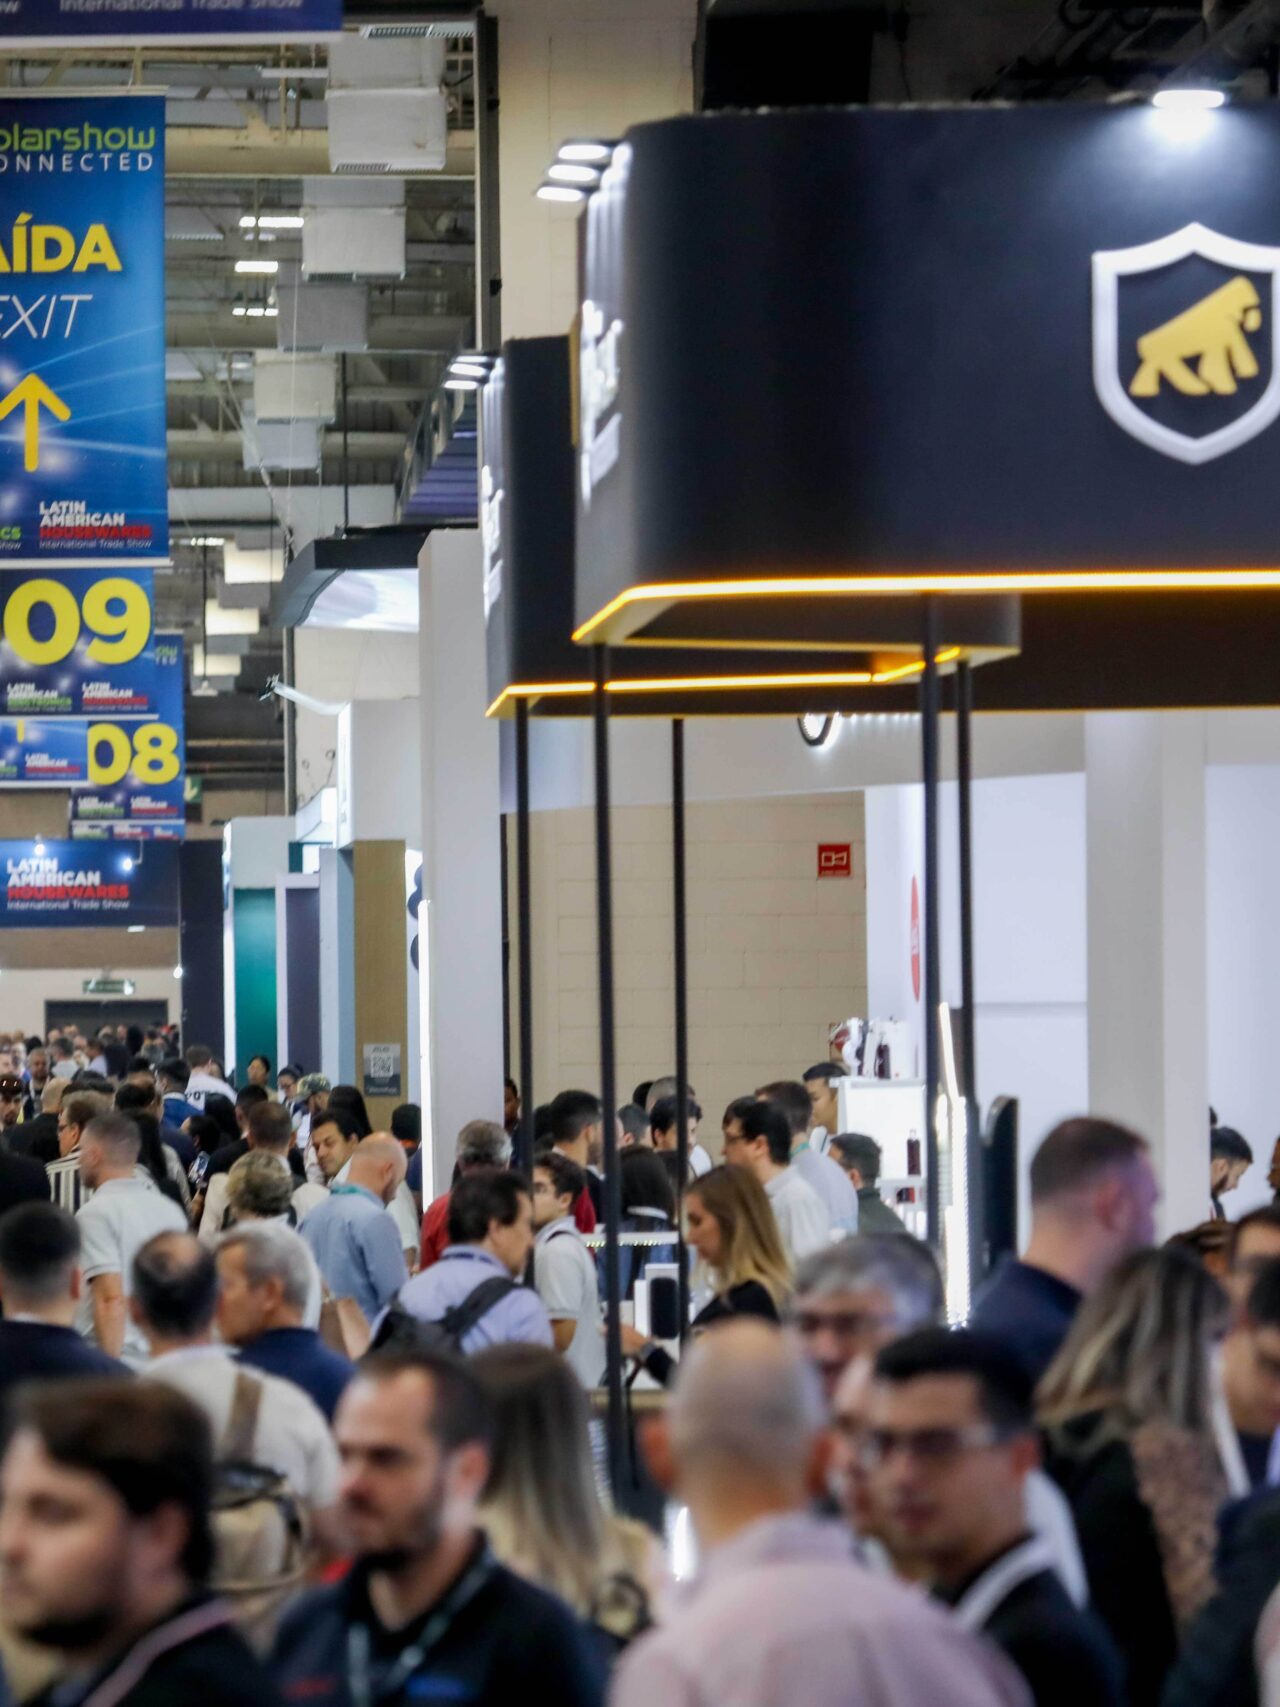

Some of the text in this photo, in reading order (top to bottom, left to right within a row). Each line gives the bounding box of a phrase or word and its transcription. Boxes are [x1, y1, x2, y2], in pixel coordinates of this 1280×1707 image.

[39, 500, 86, 516] LATIN
[40, 513, 125, 528] AMERICAN
[39, 525, 152, 540] HOUSEWARES
[39, 538, 152, 550] International Trade Show
[3, 578, 151, 666] 09
[87, 722, 180, 785] 08
[7, 858, 59, 874] LATIN
[7, 871, 101, 887] AMERICAN
[7, 885, 129, 900] HOUSEWARES
[7, 899, 130, 910] International Trade Show
